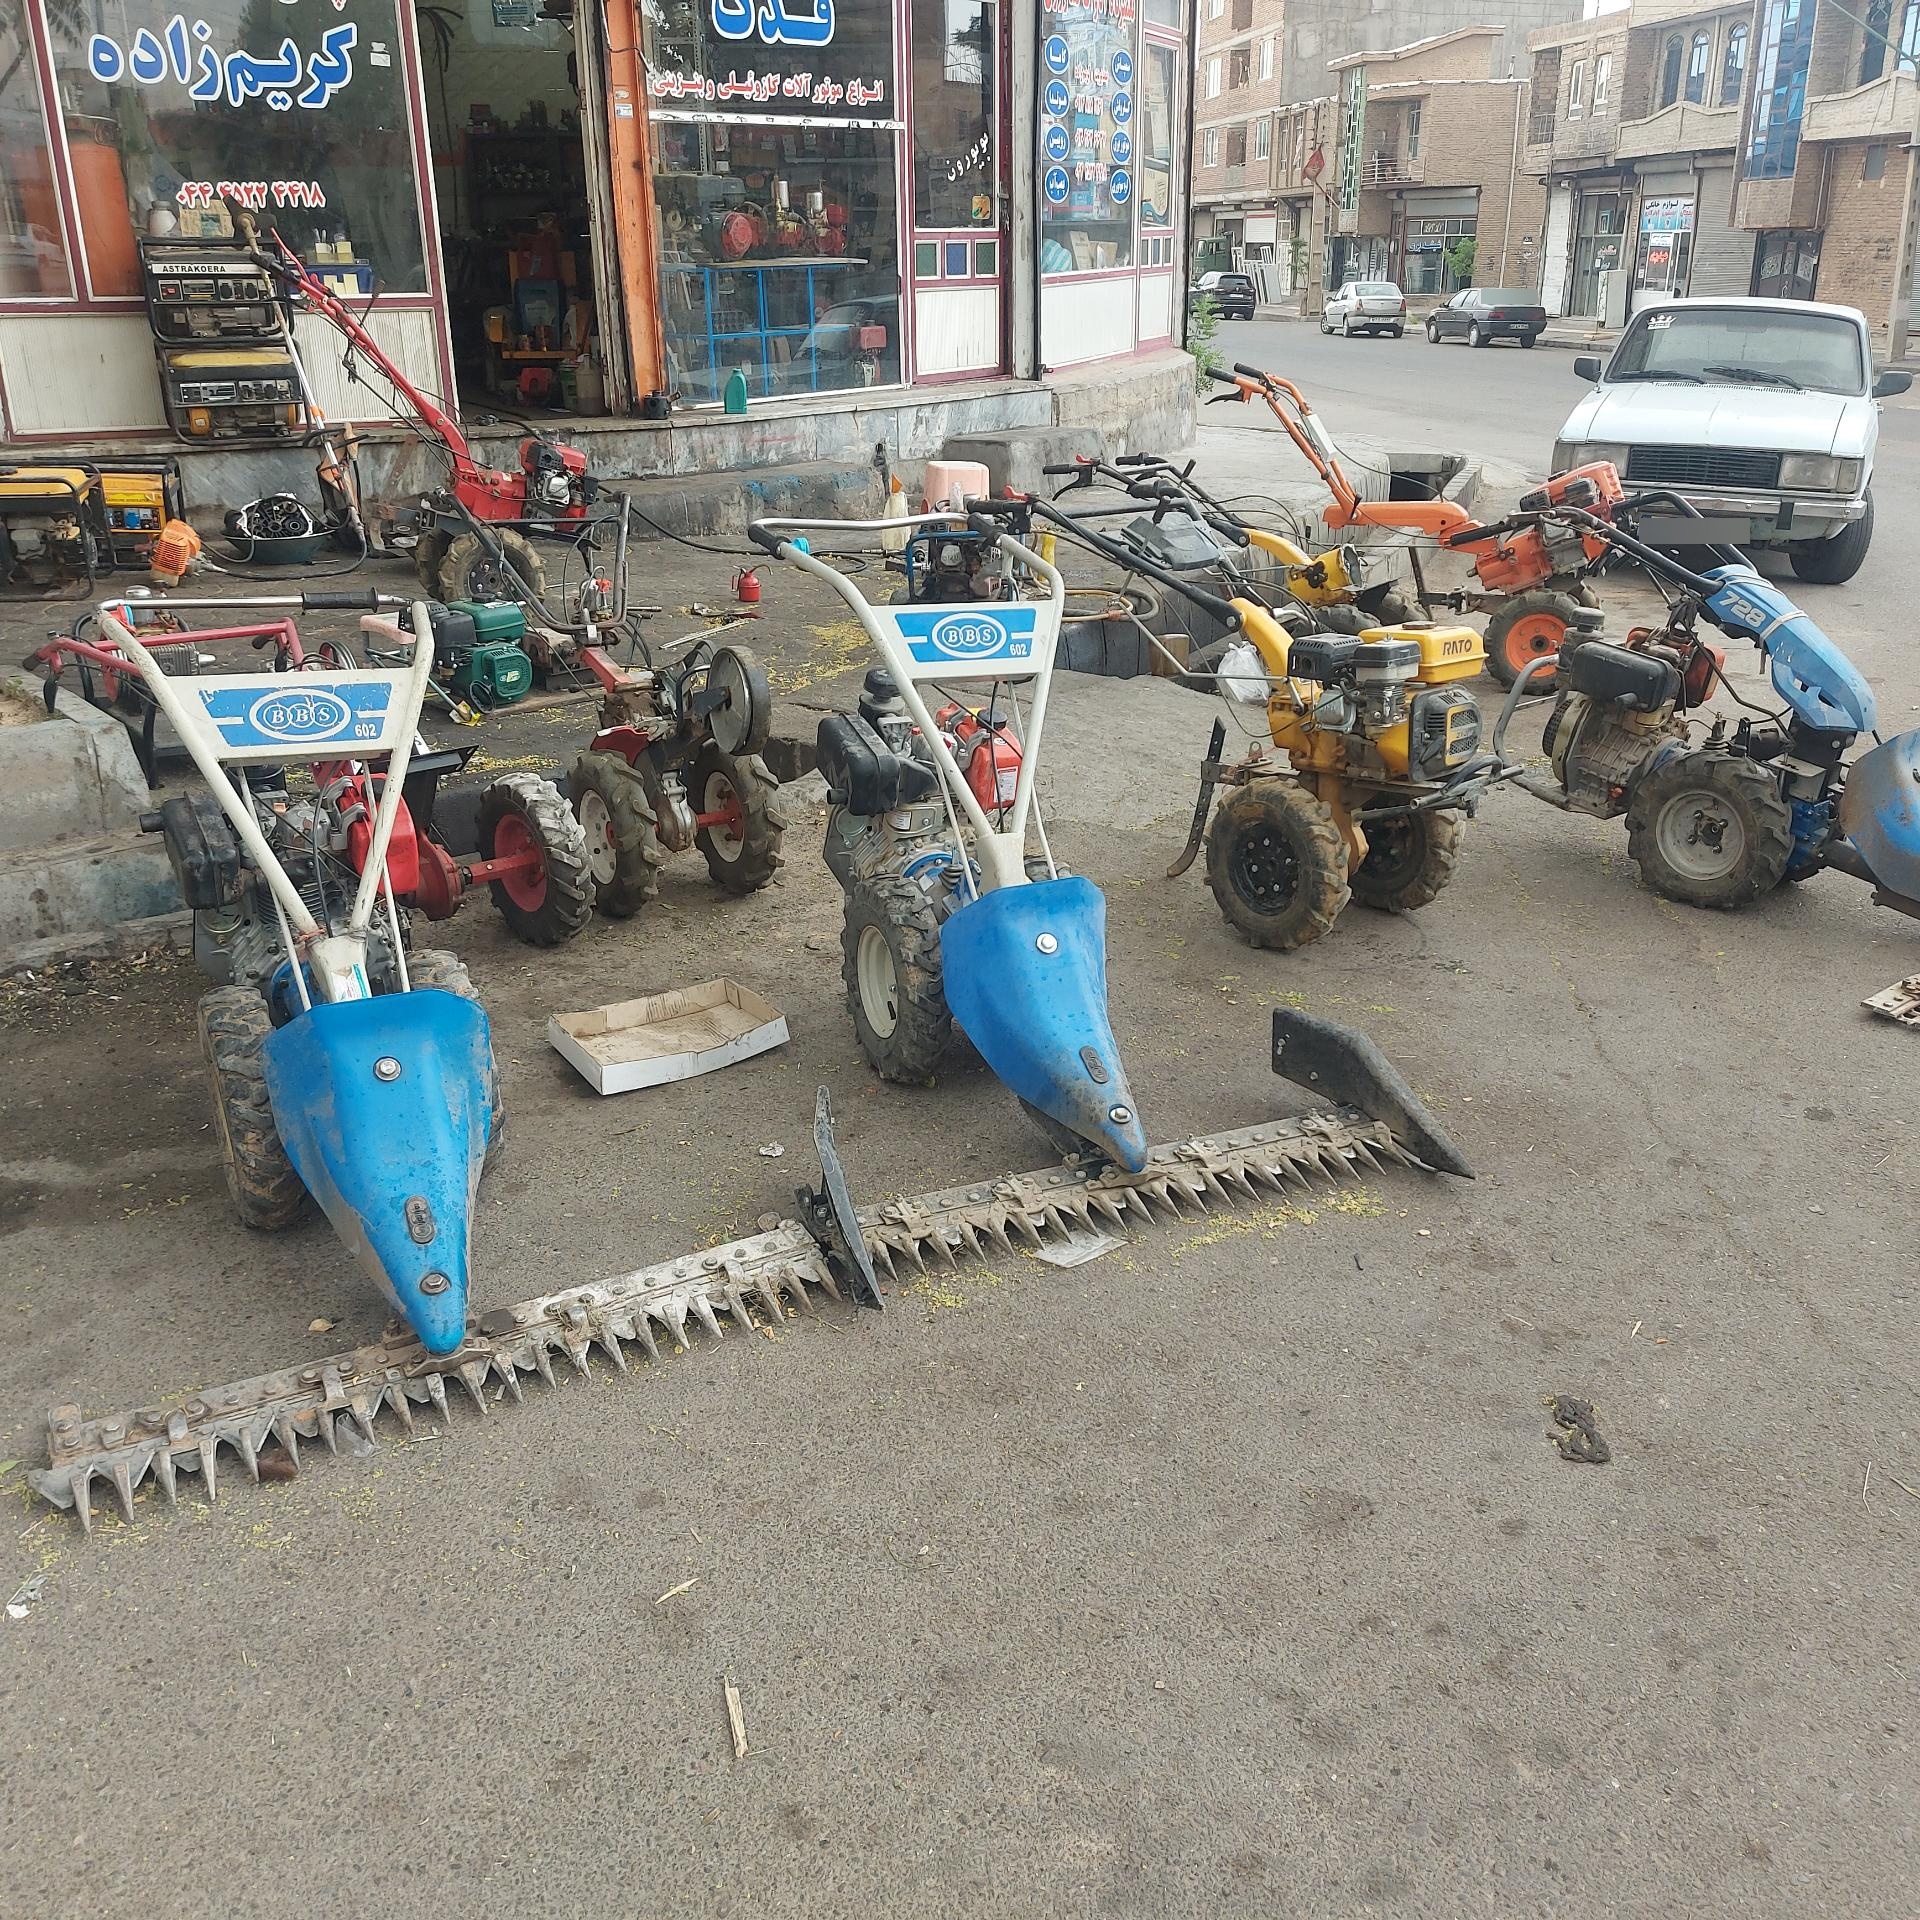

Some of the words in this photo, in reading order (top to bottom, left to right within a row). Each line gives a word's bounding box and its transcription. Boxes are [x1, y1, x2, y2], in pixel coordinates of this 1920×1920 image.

[652, 70, 704, 99] بنزینی
[706, 78, 718, 100] و
[782, 70, 812, 98] آلات
[812, 76, 843, 105] موتور
[847, 78, 884, 106] انواع
[176, 181, 214, 209] ۰۴۴
[271, 181, 326, 208] ۴۴۱۸
[1645, 201, 1661, 210] خانگی
[1662, 200, 1679, 210] لوازم
[162, 265, 226, 273] ASTRAKOERA
[1718, 591, 1767, 628] 728
[946, 626, 993, 645] BBS
[1009, 643, 1028, 656] 602
[1442, 639, 1473, 656] RATO
[268, 705, 334, 727] BBS
[354, 723, 377, 738] 602
